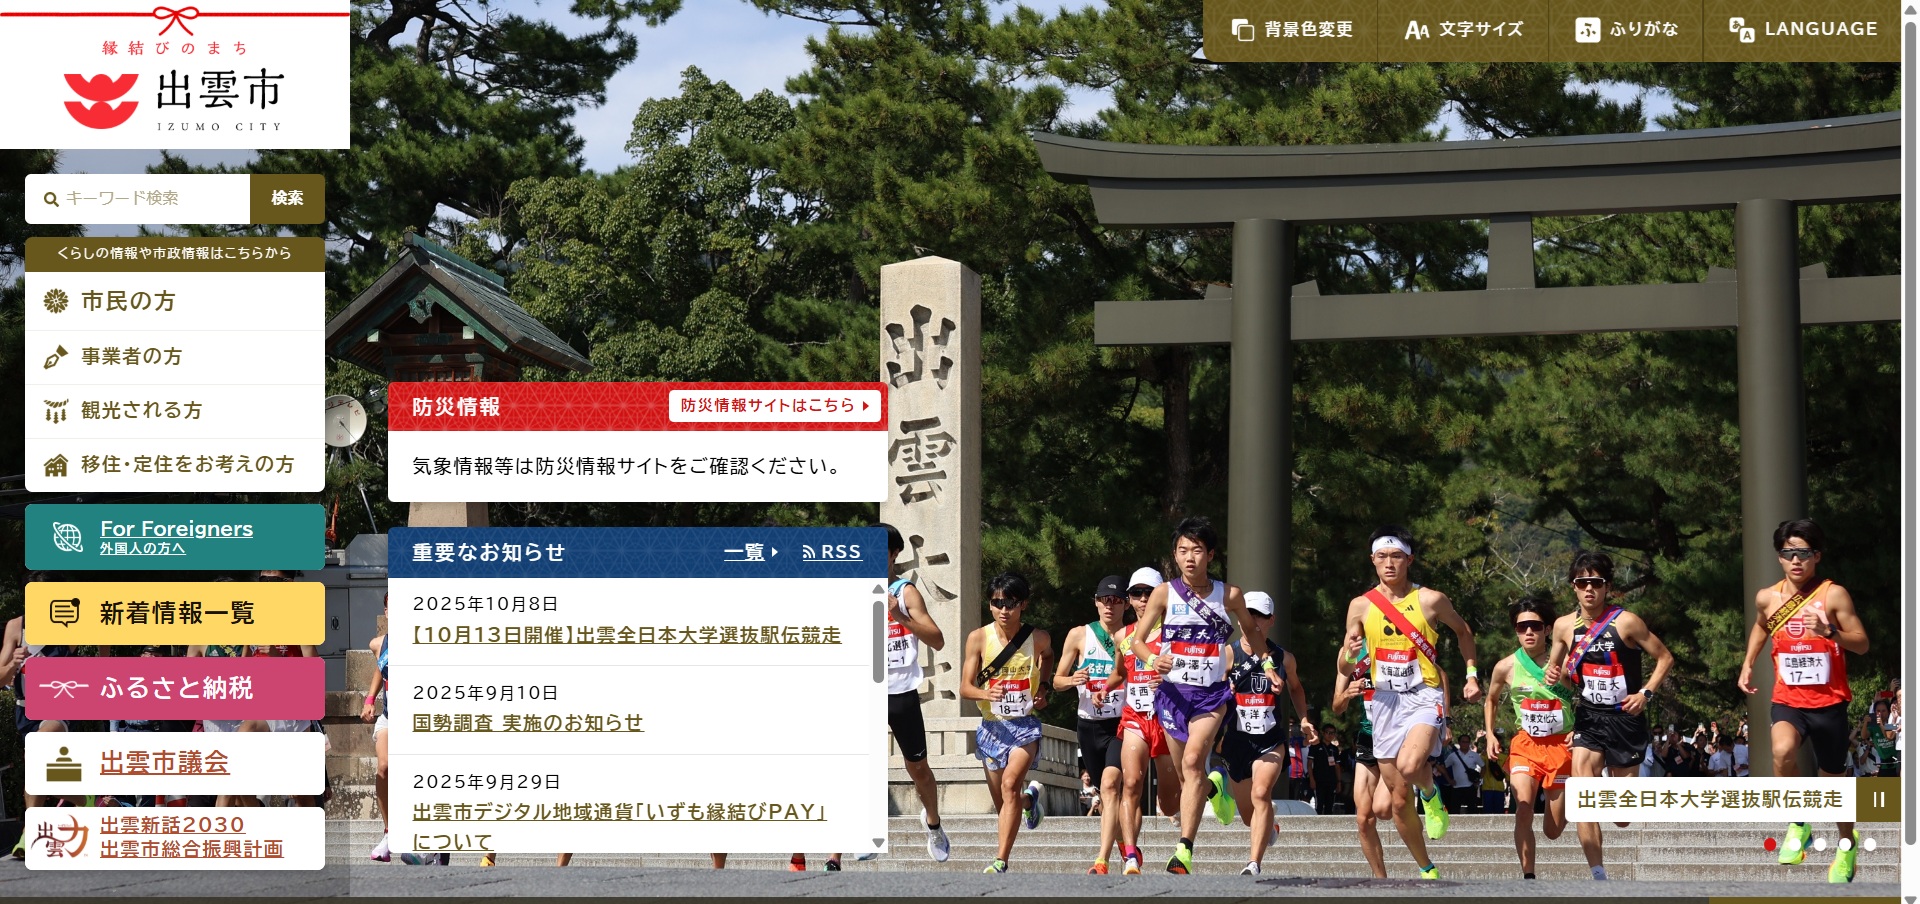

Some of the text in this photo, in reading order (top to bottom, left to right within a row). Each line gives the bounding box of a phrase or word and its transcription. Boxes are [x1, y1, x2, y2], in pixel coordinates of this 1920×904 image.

[1184, 645, 1206, 655] FUJITSU
[1387, 651, 1409, 661] FUJITSU
[1593, 667, 1611, 675] FUJITSU
[1130, 686, 1155, 696] 城西
[1245, 696, 1265, 705] FUJITSU
